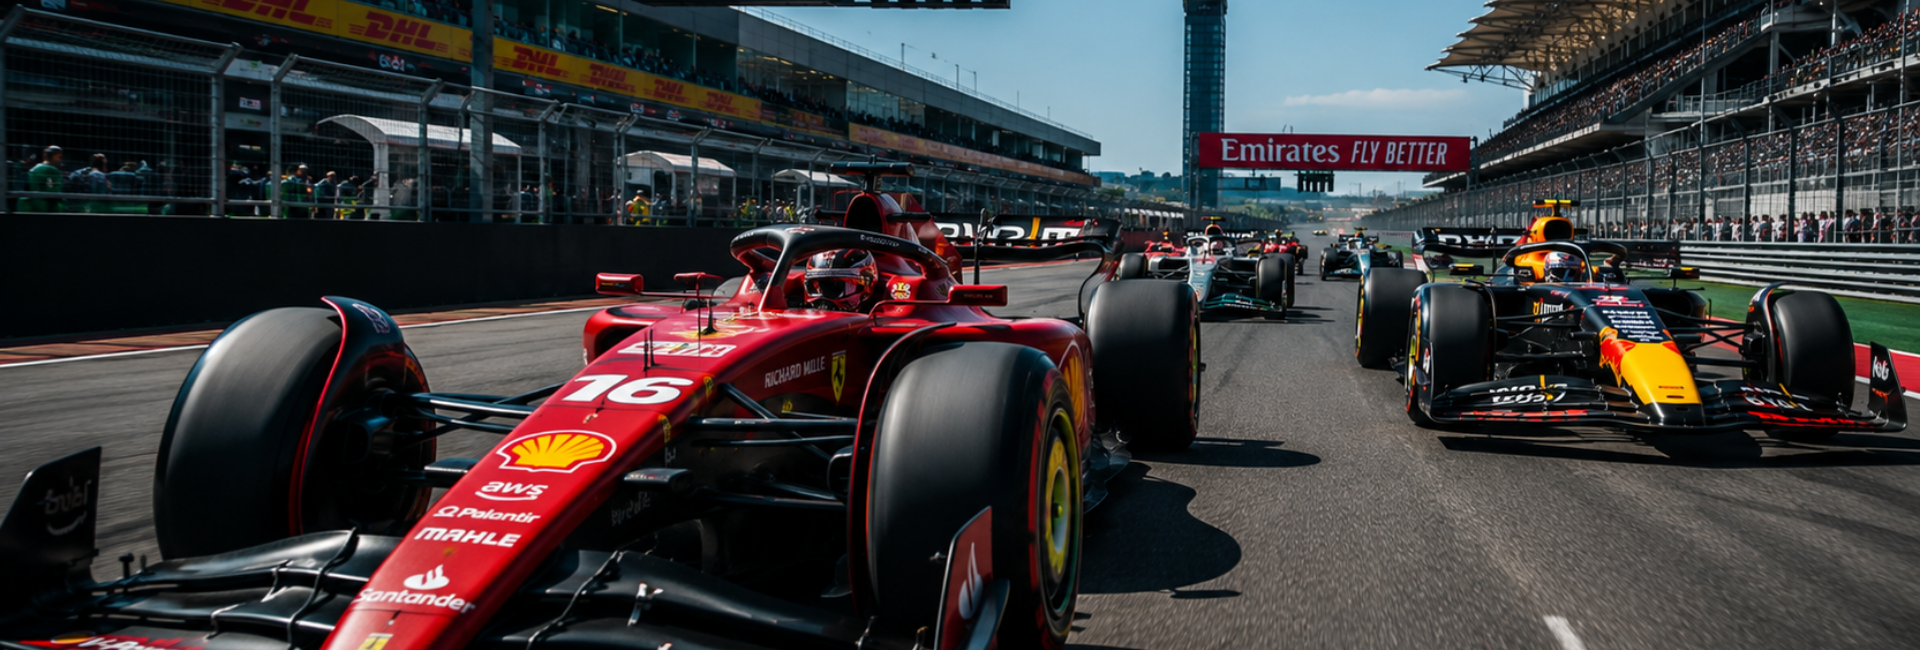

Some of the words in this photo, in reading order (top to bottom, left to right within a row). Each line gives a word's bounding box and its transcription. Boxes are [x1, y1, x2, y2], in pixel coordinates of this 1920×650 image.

[364, 11, 437, 50] DHL
[511, 45, 561, 76] DHL
[1221, 138, 1340, 163] Emirates
[1350, 140, 1380, 164] FLY
[1385, 141, 1448, 165] BETTER
[764, 363, 802, 388] RICHARD
[562, 374, 694, 404] 16
[481, 481, 549, 495] aws
[457, 507, 541, 523] Palantir
[414, 527, 522, 548] MAHLE
[350, 587, 476, 613] Santander
